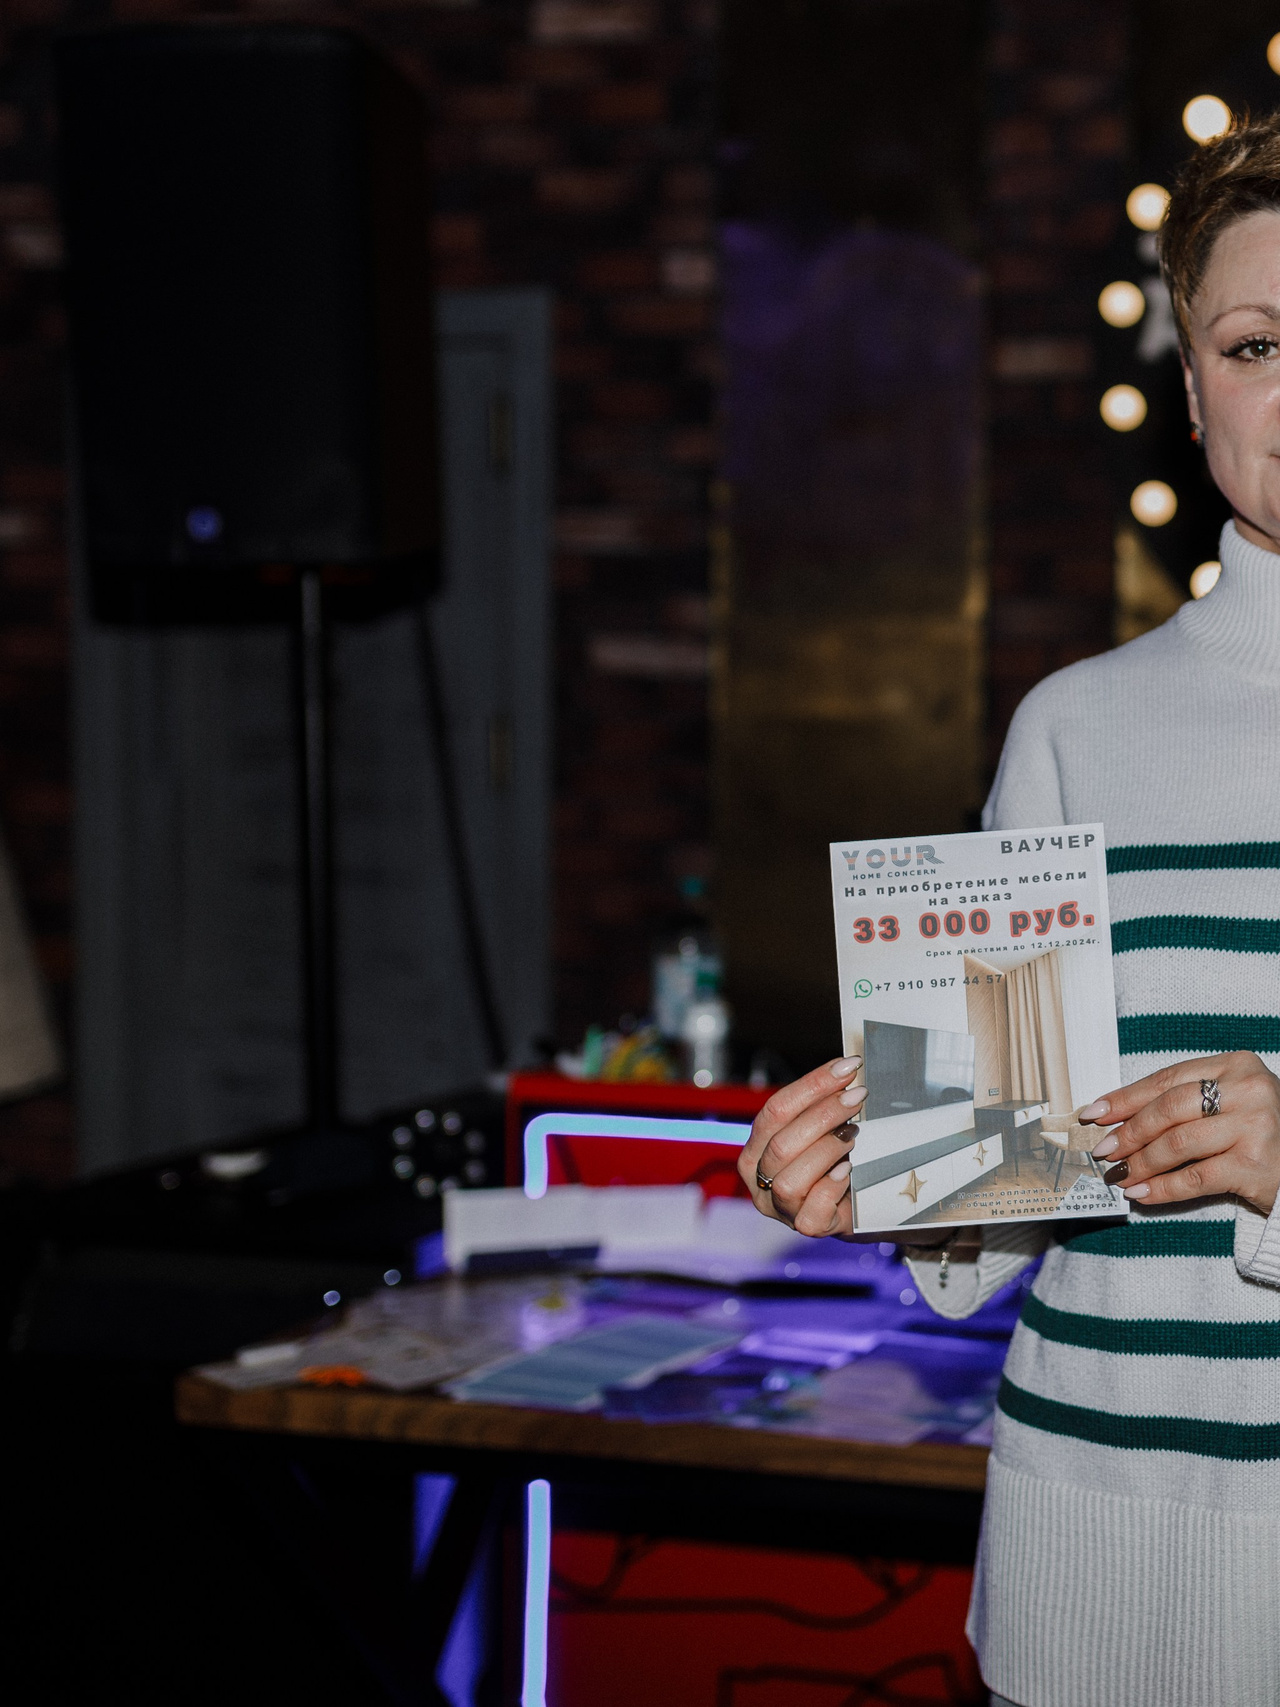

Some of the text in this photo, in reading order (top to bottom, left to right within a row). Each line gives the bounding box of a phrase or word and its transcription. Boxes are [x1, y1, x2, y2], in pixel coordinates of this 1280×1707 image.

[1000, 833, 1095, 854] ВАУЧЕР
[841, 844, 945, 871] YOUR
[852, 868, 937, 880] HOME CONCERN
[844, 871, 1087, 898] На приобретение мебели
[928, 892, 1013, 906] на заказ
[853, 901, 1095, 944] 33 000 руб.
[925, 950, 952, 958] Срок
[956, 946, 1008, 956] действия
[1013, 944, 1026, 952] до
[874, 974, 1003, 992] +7 910 987 44 57
[991, 1208, 1006, 1216] Не
